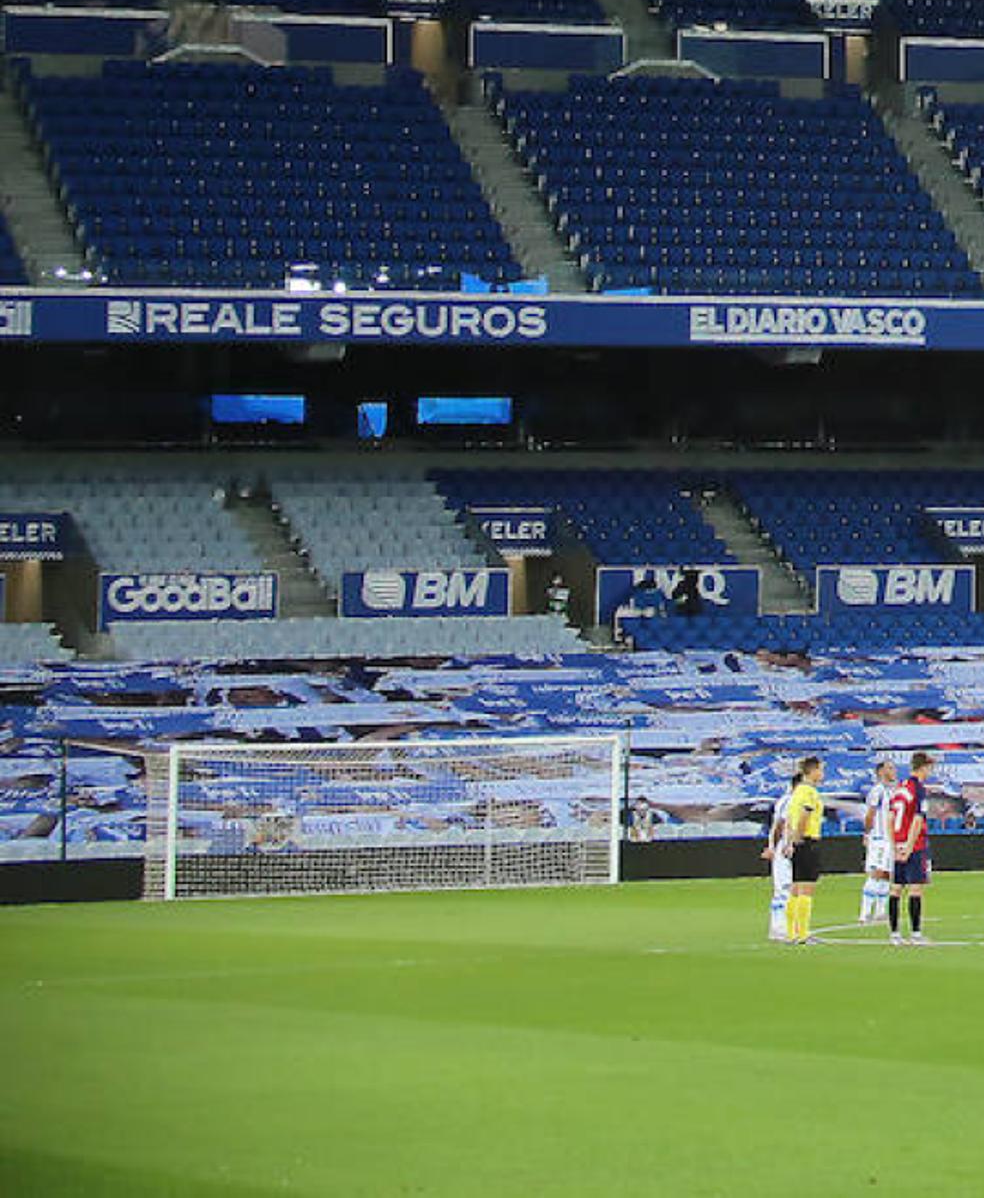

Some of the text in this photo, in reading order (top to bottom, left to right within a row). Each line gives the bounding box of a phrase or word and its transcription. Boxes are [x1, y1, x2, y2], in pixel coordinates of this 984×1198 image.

[145, 303, 548, 338] REALE SEGUROS
[690, 306, 926, 336] EL DIARIO VASCO
[411, 571, 490, 608] BM
[883, 568, 956, 605] BM
